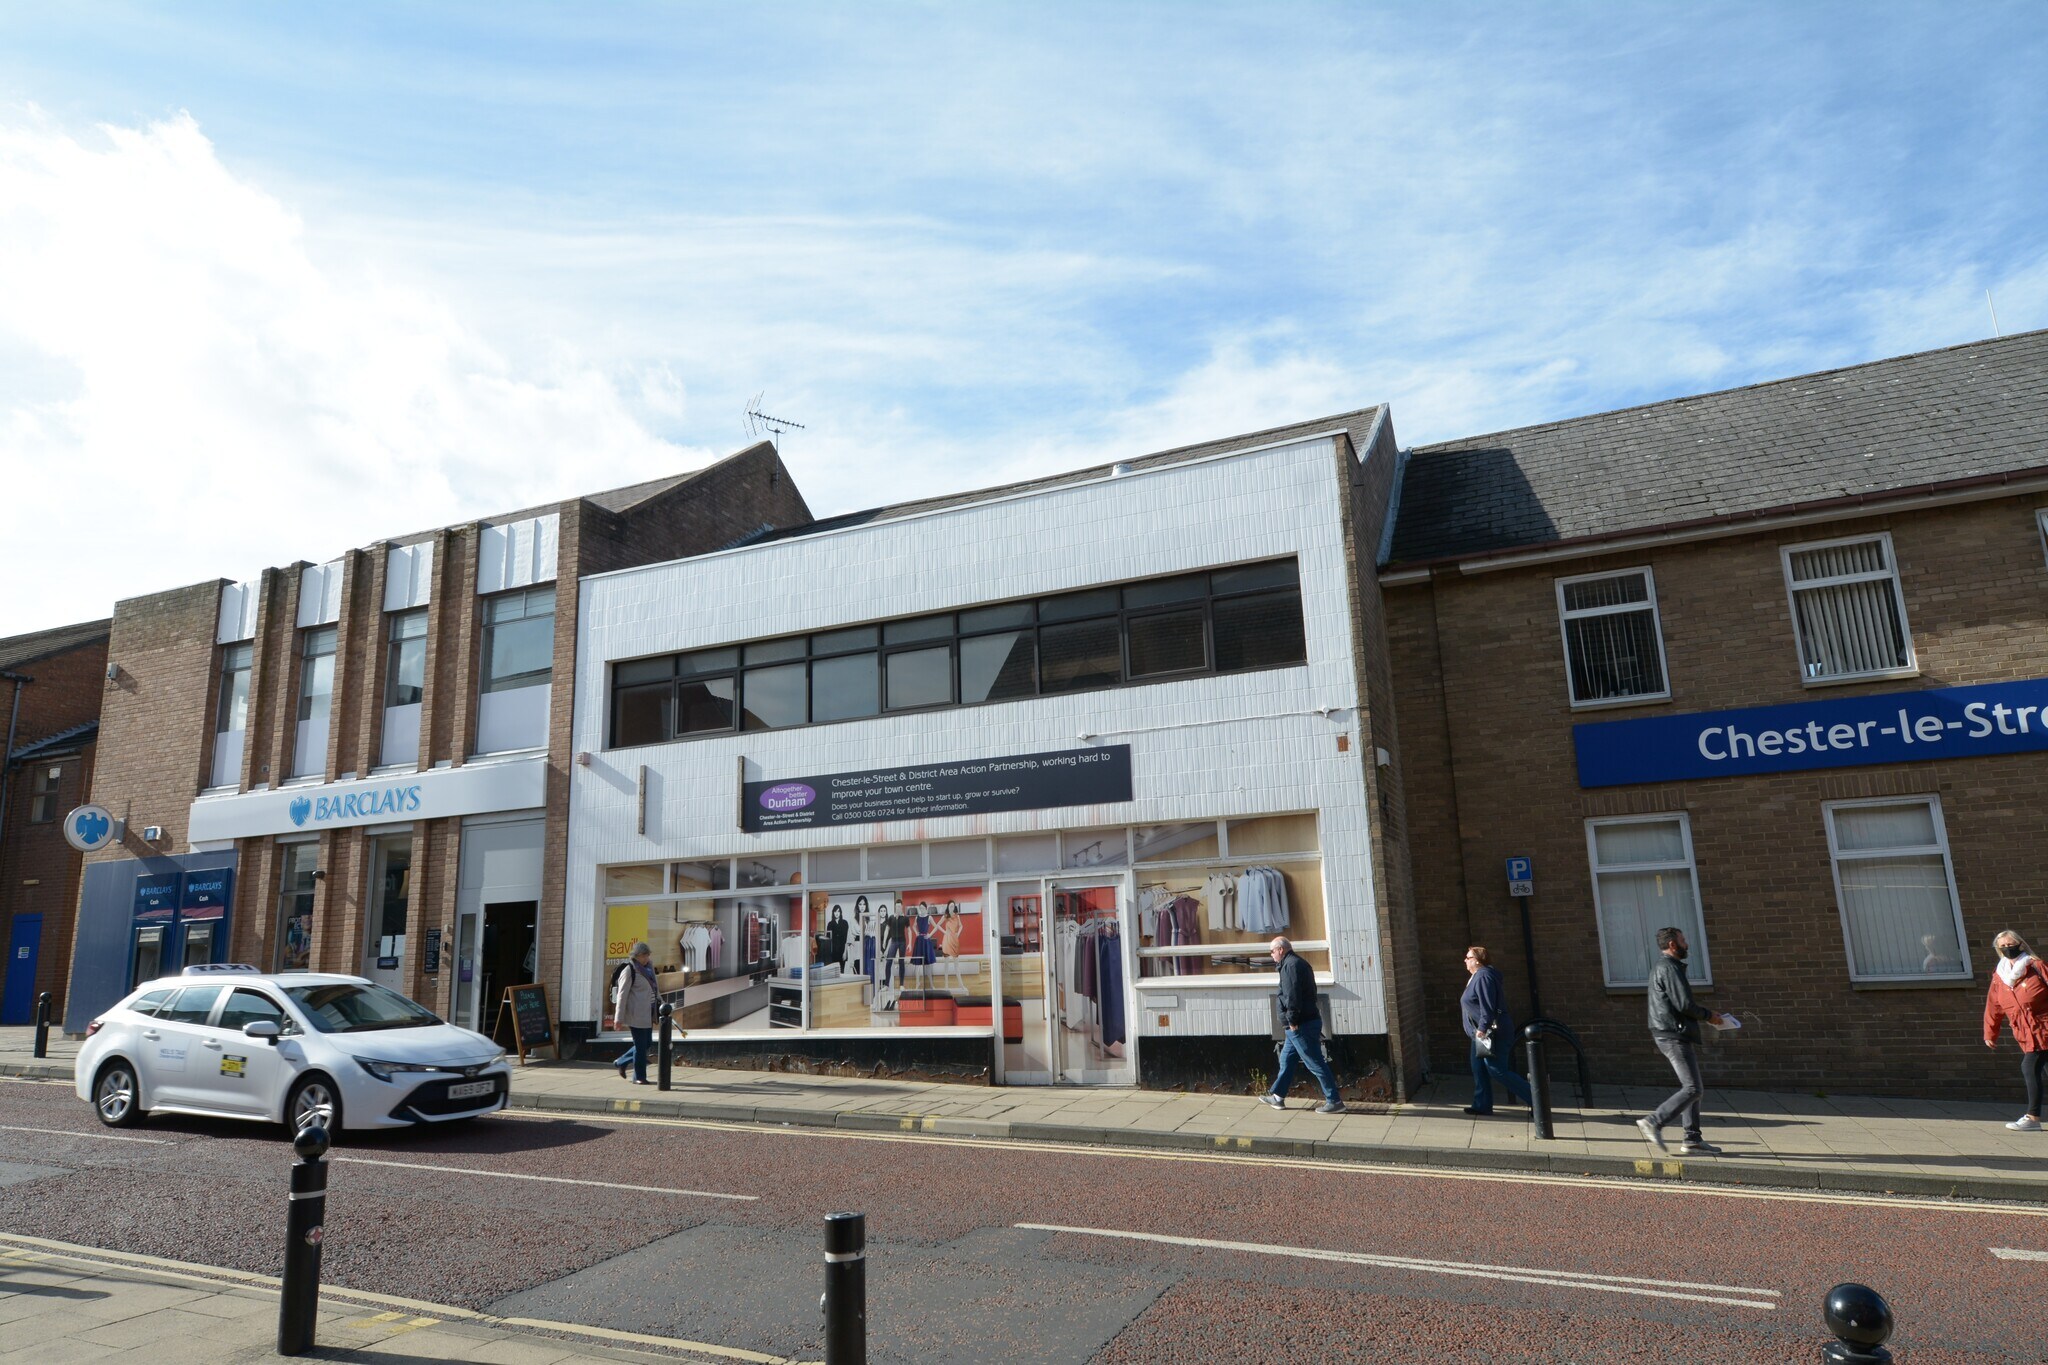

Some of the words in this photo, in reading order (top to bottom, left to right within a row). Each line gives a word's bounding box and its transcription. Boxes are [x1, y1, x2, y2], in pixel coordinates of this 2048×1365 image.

[1697, 702, 2048, 761] Chester-le-Str
[831, 774, 897, 787] Chester-le-Street
[899, 772, 907, 781] &
[908, 770, 937, 780] District
[939, 768, 958, 777] Area
[960, 765, 987, 775] Action
[988, 760, 1040, 772] Partnership,
[1042, 755, 1077, 767] working
[1078, 753, 1099, 763] hard
[1101, 752, 1111, 761] to
[771, 785, 803, 795] Altogether
[788, 791, 808, 799] better
[865, 787, 882, 798] your
[884, 785, 903, 794] town
[905, 782, 934, 793] centre.
[315, 785, 422, 821] BARCLAYS
[768, 797, 806, 809] Durham
[831, 803, 848, 811] Does
[849, 802, 863, 811] your
[864, 799, 893, 808] business
[894, 797, 910, 805] need
[911, 795, 926, 804] help
[936, 793, 951, 801] start
[952, 793, 963, 801] up,
[964, 791, 981, 800] grow
[991, 787, 1020, 797] survive?
[831, 812, 843, 821] Call
[843, 811, 862, 820] 0300
[862, 810, 877, 818] 026
[877, 808, 895, 817] 0724
[896, 807, 905, 815] for
[906, 806, 929, 814] further
[929, 802, 969, 812] information.
[1511, 860, 1527, 880] P
[146, 886, 172, 895] BARCLAYS
[194, 881, 222, 891] BARCLAYS
[609, 937, 639, 955] savi
[193, 964, 254, 972] TAXI
